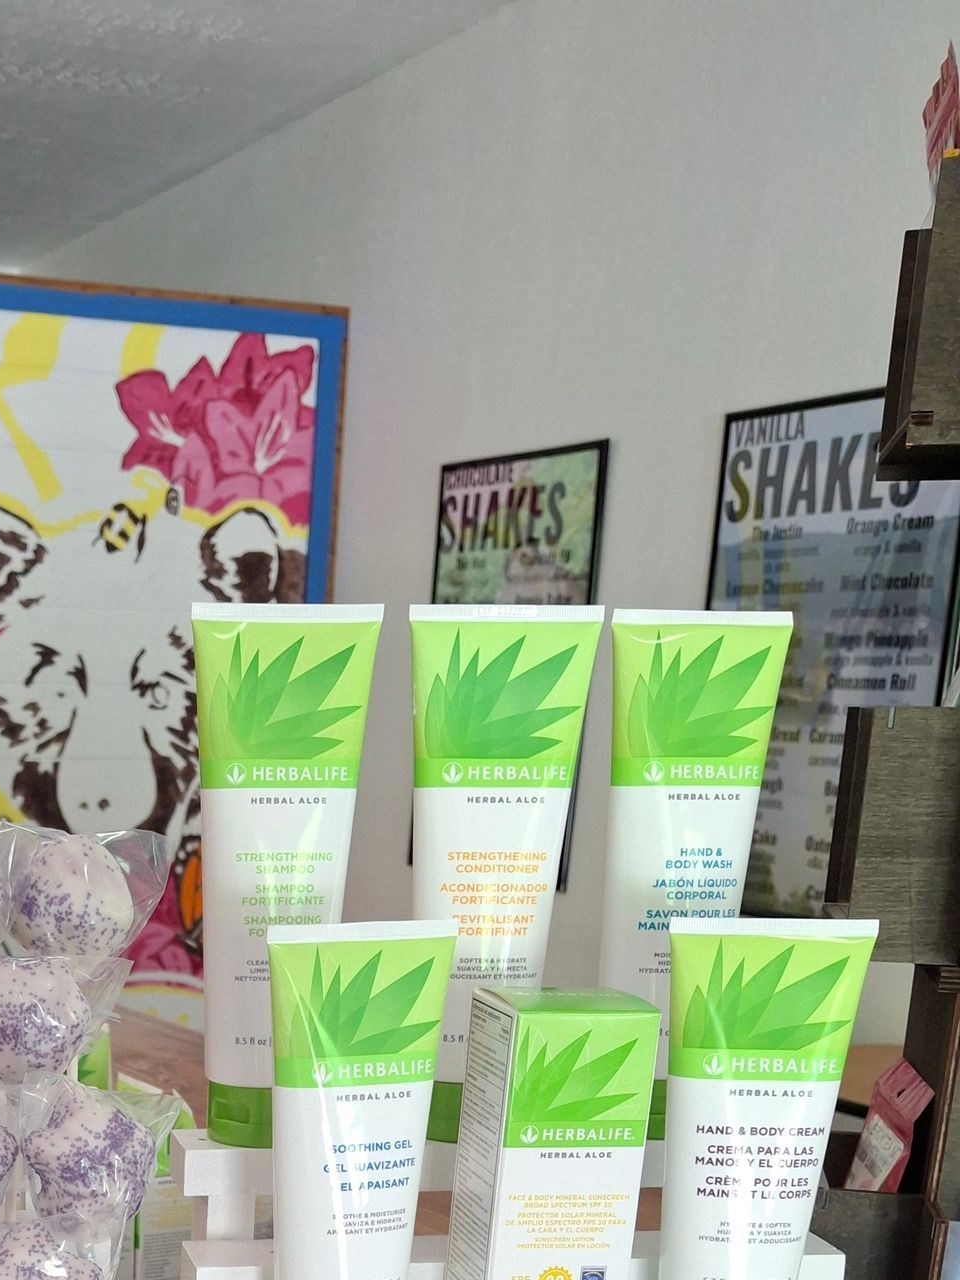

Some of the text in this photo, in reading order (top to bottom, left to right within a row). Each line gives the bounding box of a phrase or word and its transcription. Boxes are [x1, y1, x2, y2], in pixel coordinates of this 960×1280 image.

[734, 411, 805, 448] VANILLA
[439, 481, 566, 553] SHAKES
[846, 513, 935, 536] Orange Cream
[871, 572, 935, 590] Chocolate
[866, 629, 929, 651] Pineapple
[828, 673, 917, 691] Cinnamon Roll
[252, 766, 348, 782] HERBALIFE
[467, 765, 567, 781] HERBALIFE
[670, 764, 760, 780] HERBALIFE
[250, 797, 328, 805] HERBAL ALOE
[466, 796, 545, 804] HERBAL ALOE
[668, 793, 740, 801] HERBAL ALOE
[447, 851, 547, 862] STRENGTHENING
[680, 847, 722, 856] HAND &
[235, 852, 333, 862] STRENGTHENING
[455, 864, 540, 874] CONDITIONER
[665, 859, 733, 869] BODY WASH
[255, 865, 315, 875] SHAMPOO
[652, 876, 738, 889] JABÓN LÍQUIDO
[255, 884, 315, 894] SHAMPOO
[440, 883, 548, 893] ACONDICIONADOR
[666, 890, 727, 900] CORPORAL
[241, 896, 325, 906] FORTIFICANTE
[452, 896, 538, 905] FORTIFICANTE
[646, 908, 736, 918] SAVON POUR LES
[243, 915, 322, 925] SHAMPOOING
[638, 921, 670, 931] MAIN
[235, 1036, 268, 1046] 8.5 fl oz
[442, 1034, 456, 1043] 8.5
[337, 1058, 432, 1080] HERBALIFE
[731, 1057, 837, 1074] HERBALIFE
[336, 1090, 412, 1102] HERBAL ALOE
[729, 1089, 777, 1097] HERBAL
[542, 1127, 635, 1141] HERBALIFE
[696, 1124, 825, 1136] HAND & BODY CREAM
[332, 1139, 413, 1153] SOOTHING GEL
[707, 1144, 814, 1156] CREMA PARA LAS
[584, 1151, 613, 1159] ALOE
[747, 1158, 756, 1167] Y
[758, 1159, 773, 1168] EL
[777, 1158, 819, 1168] CUERPO
[358, 1177, 410, 1191] APAISANT
[705, 1174, 741, 1186] CRÈM
[791, 1178, 809, 1187] LES
[779, 1189, 811, 1199] CORPS
